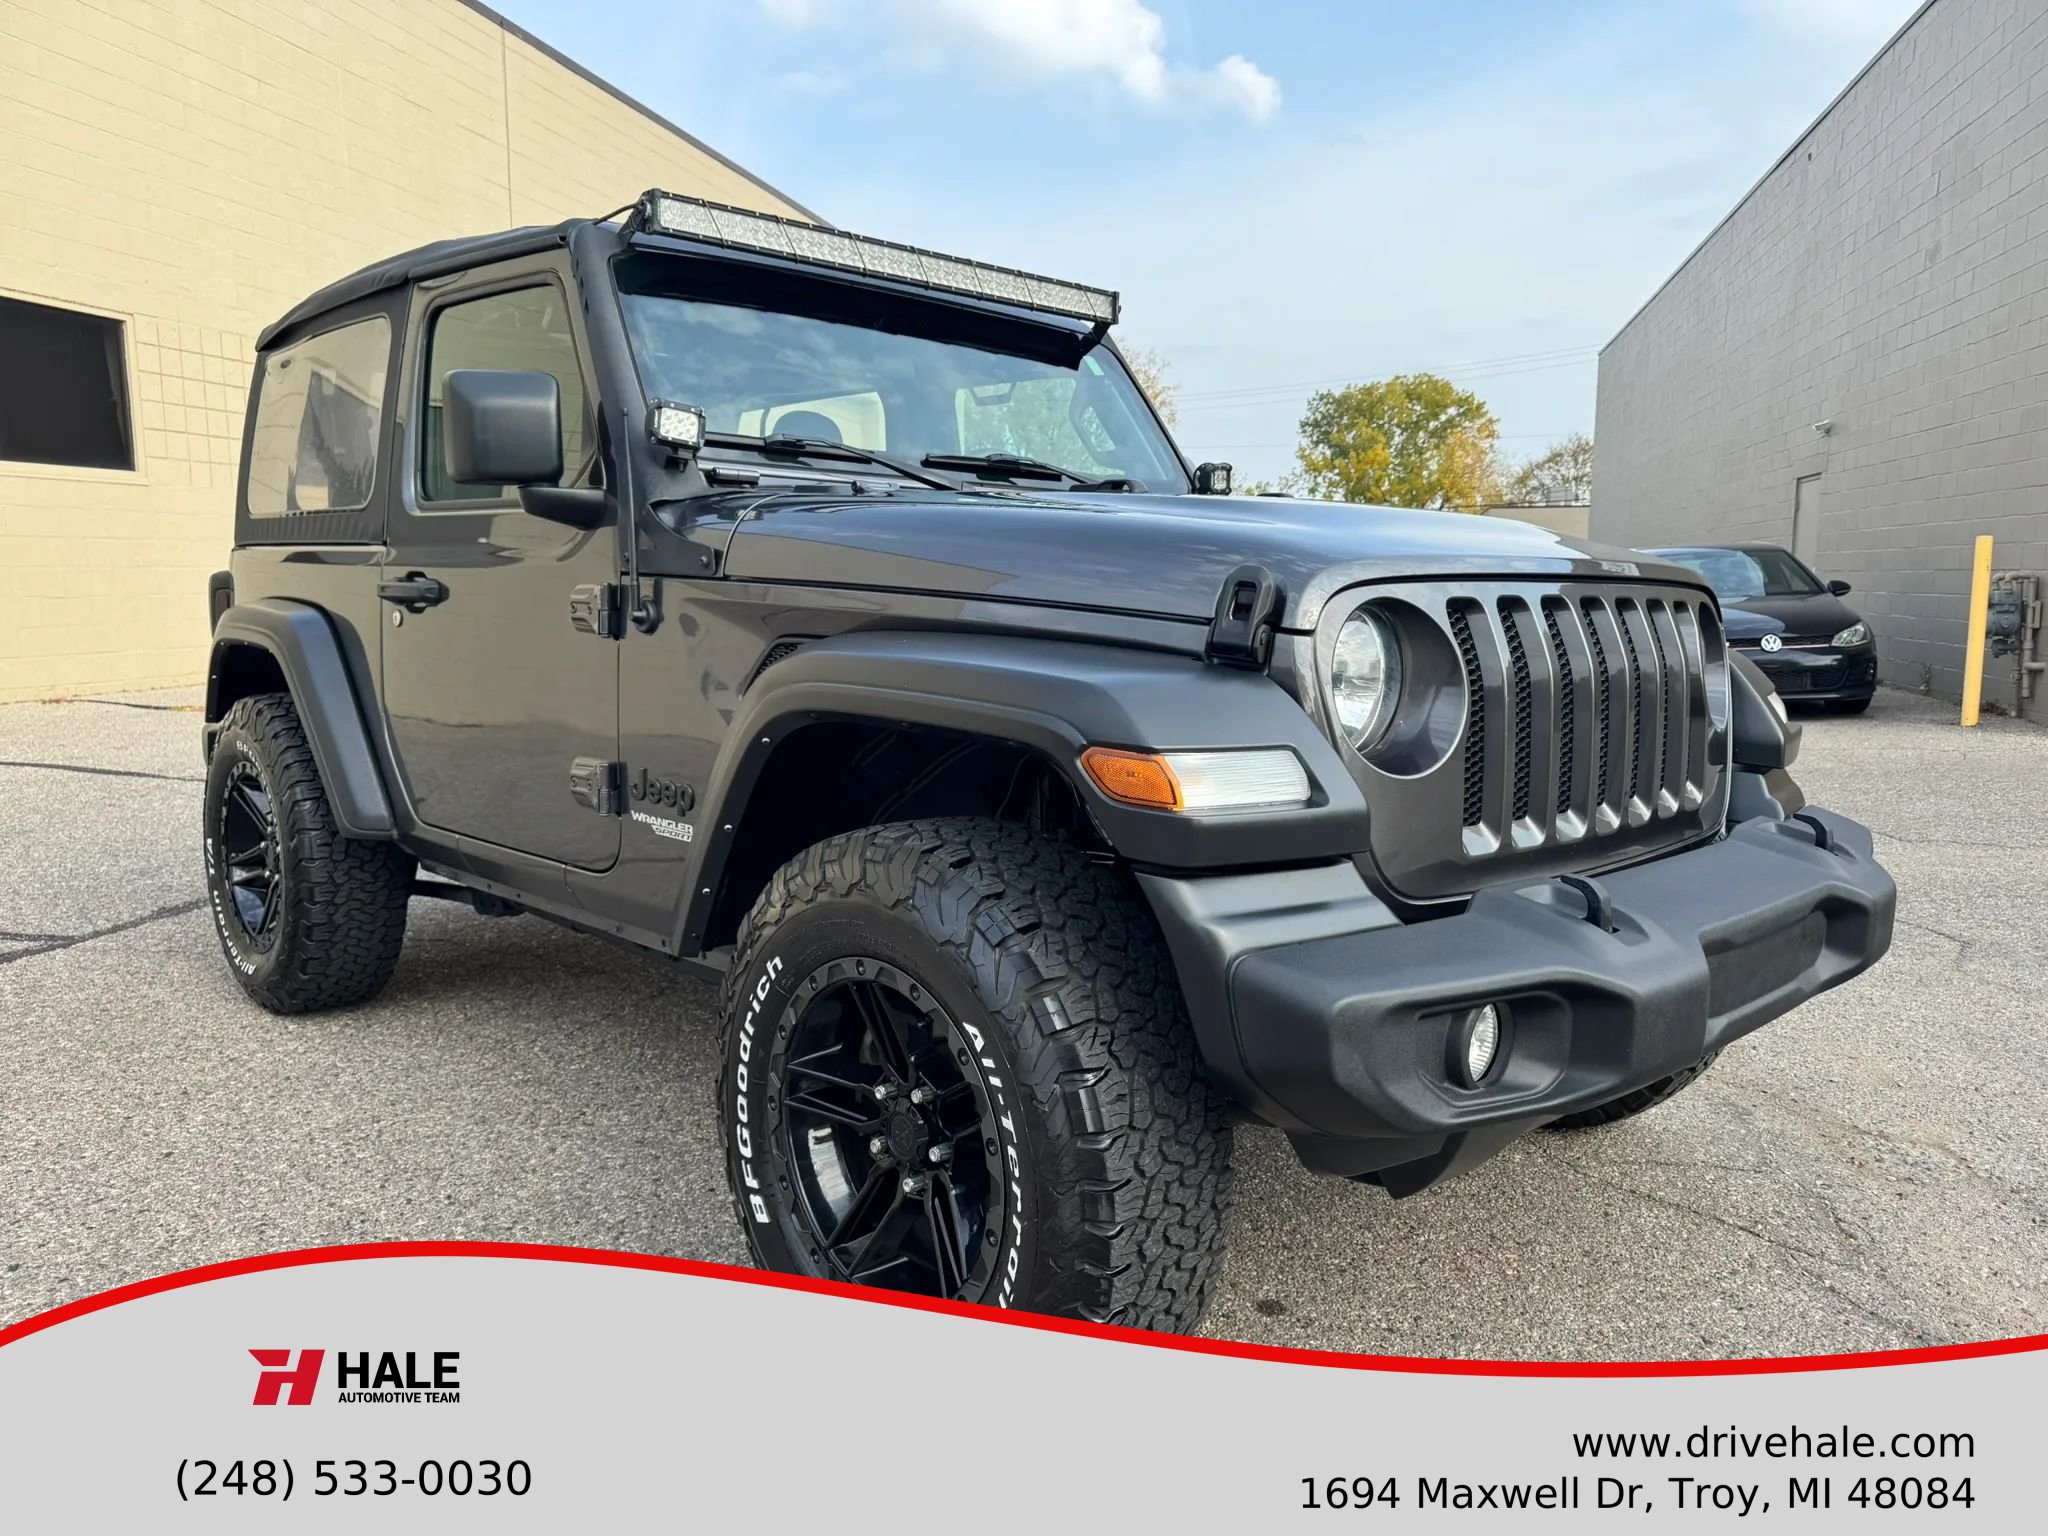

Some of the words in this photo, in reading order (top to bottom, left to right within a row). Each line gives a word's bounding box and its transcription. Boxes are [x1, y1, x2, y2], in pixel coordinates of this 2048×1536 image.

[630, 767, 695, 817] Jeep
[631, 810, 694, 834] WRANGLER
[654, 826, 692, 841] SPORT
[736, 955, 783, 1224] BFGoodrich
